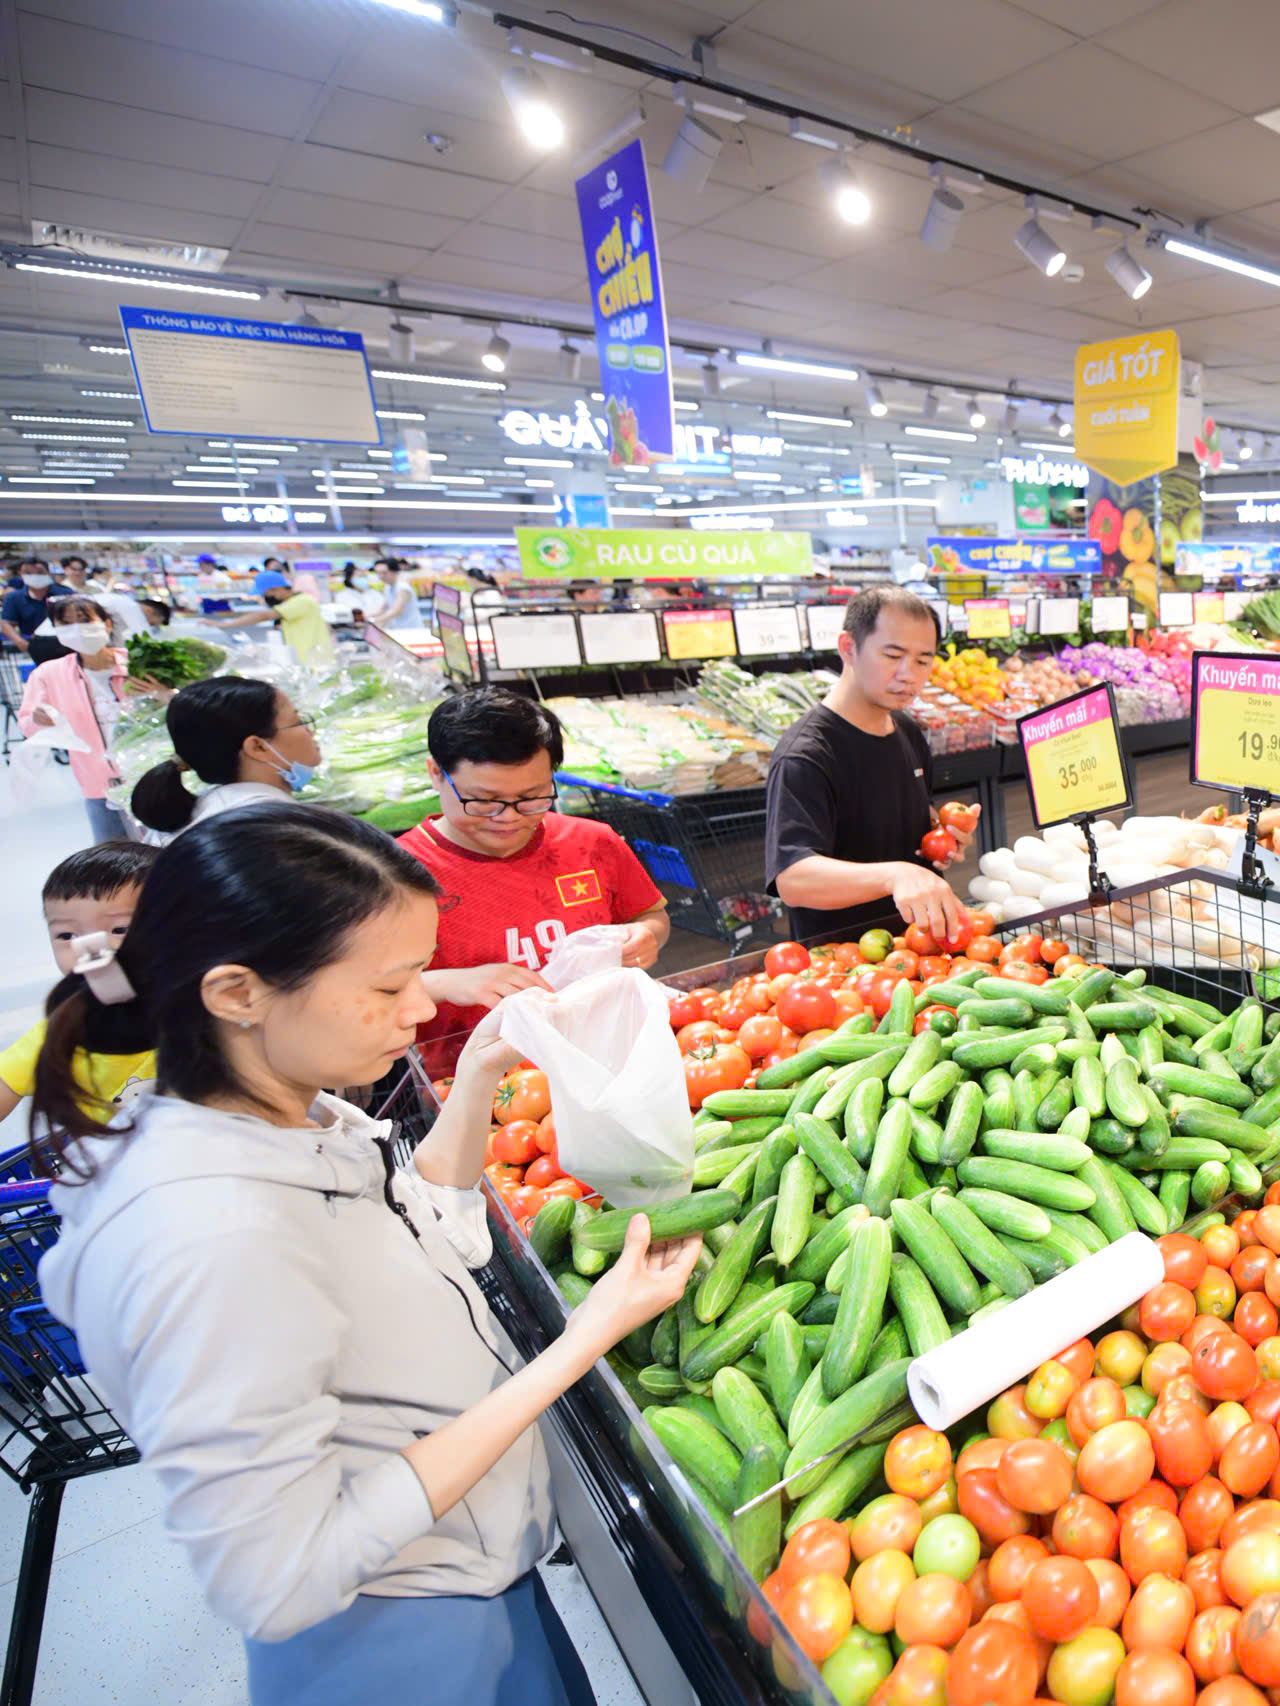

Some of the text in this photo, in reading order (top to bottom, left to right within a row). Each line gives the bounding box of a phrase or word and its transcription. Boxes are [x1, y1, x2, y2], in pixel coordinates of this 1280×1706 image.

[142, 314, 188, 329] THÔNG
[190, 317, 217, 332] BÁO
[218, 320, 233, 334] VỀ
[236, 323, 262, 338] VIỆC
[288, 329, 322, 345] HÀNG
[1083, 339, 1166, 386] GIÁ TỐT
[597, 538, 756, 565] RAU CỦ QUẢ
[1200, 664, 1257, 689] Khuyến
[1023, 713, 1065, 743] Khuyến
[1238, 730, 1264, 761] 19
[1058, 763, 1079, 790] 35
